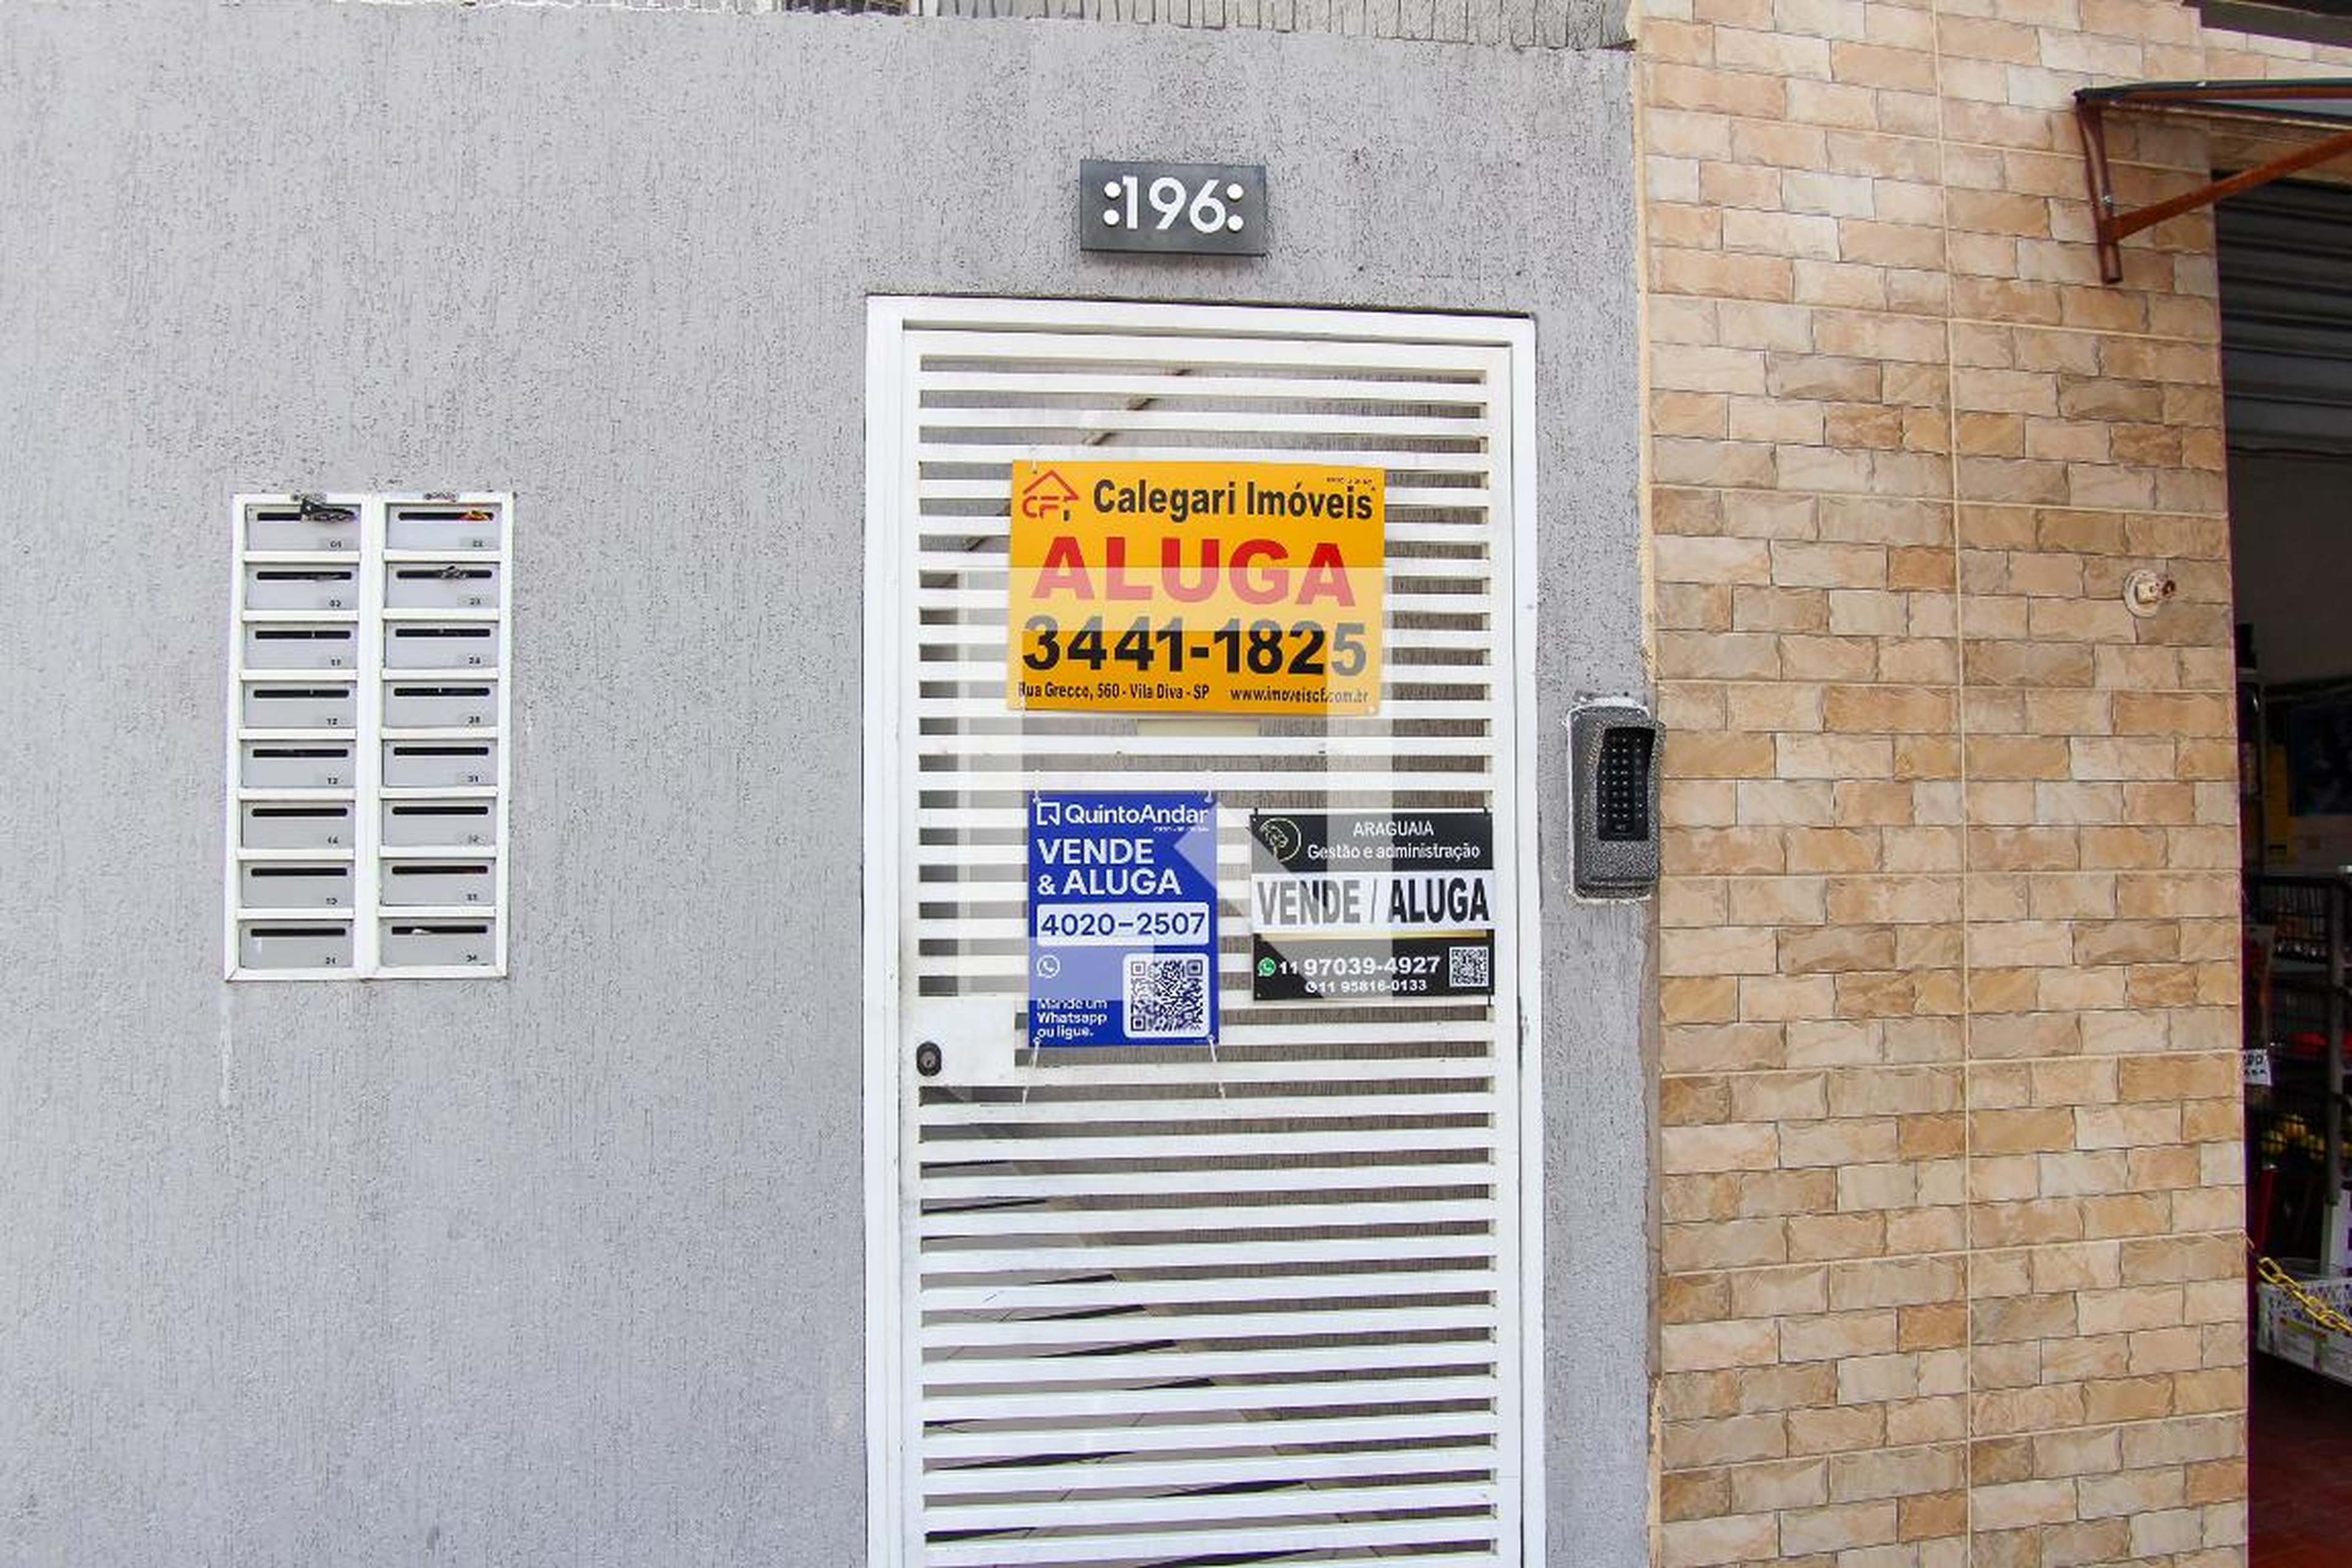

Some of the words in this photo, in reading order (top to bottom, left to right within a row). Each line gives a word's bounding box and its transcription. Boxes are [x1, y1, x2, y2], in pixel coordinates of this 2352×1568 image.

[1122, 175, 1226, 233] 196
[1093, 479, 1234, 523] Calegari
[1247, 481, 1373, 520] Imóveis
[1031, 536, 1356, 607] ALUGA
[1022, 614, 1367, 677] 3441-1825
[1018, 682, 1041, 697] Rua
[1097, 683, 1120, 699] 560
[1130, 683, 1154, 698] Vila
[1157, 684, 1183, 699] Diva
[1193, 684, 1210, 699] SP
[1065, 804, 1209, 824] QuintoAndar
[1352, 820, 1435, 837] ARAGUAIA
[1036, 838, 1155, 865] VENDE
[1307, 843, 1360, 859] Gestão
[1363, 847, 1374, 858] e
[1376, 842, 1481, 861] administração
[1036, 874, 1057, 895] &
[1061, 867, 1183, 895] ALUGA
[1257, 879, 1361, 925] VENDE
[1387, 876, 1490, 924] ALUGA
[1041, 911, 1206, 937] 4020-2507
[1279, 960, 1298, 975] 11
[1303, 956, 1441, 977] 97039-4927
[1318, 981, 1335, 993] 11
[1085, 999, 1107, 1009] um
[1036, 1012, 1108, 1025] Whatsapp
[1036, 1028, 1055, 1038] ou
[1057, 1025, 1094, 1040] ligue.
